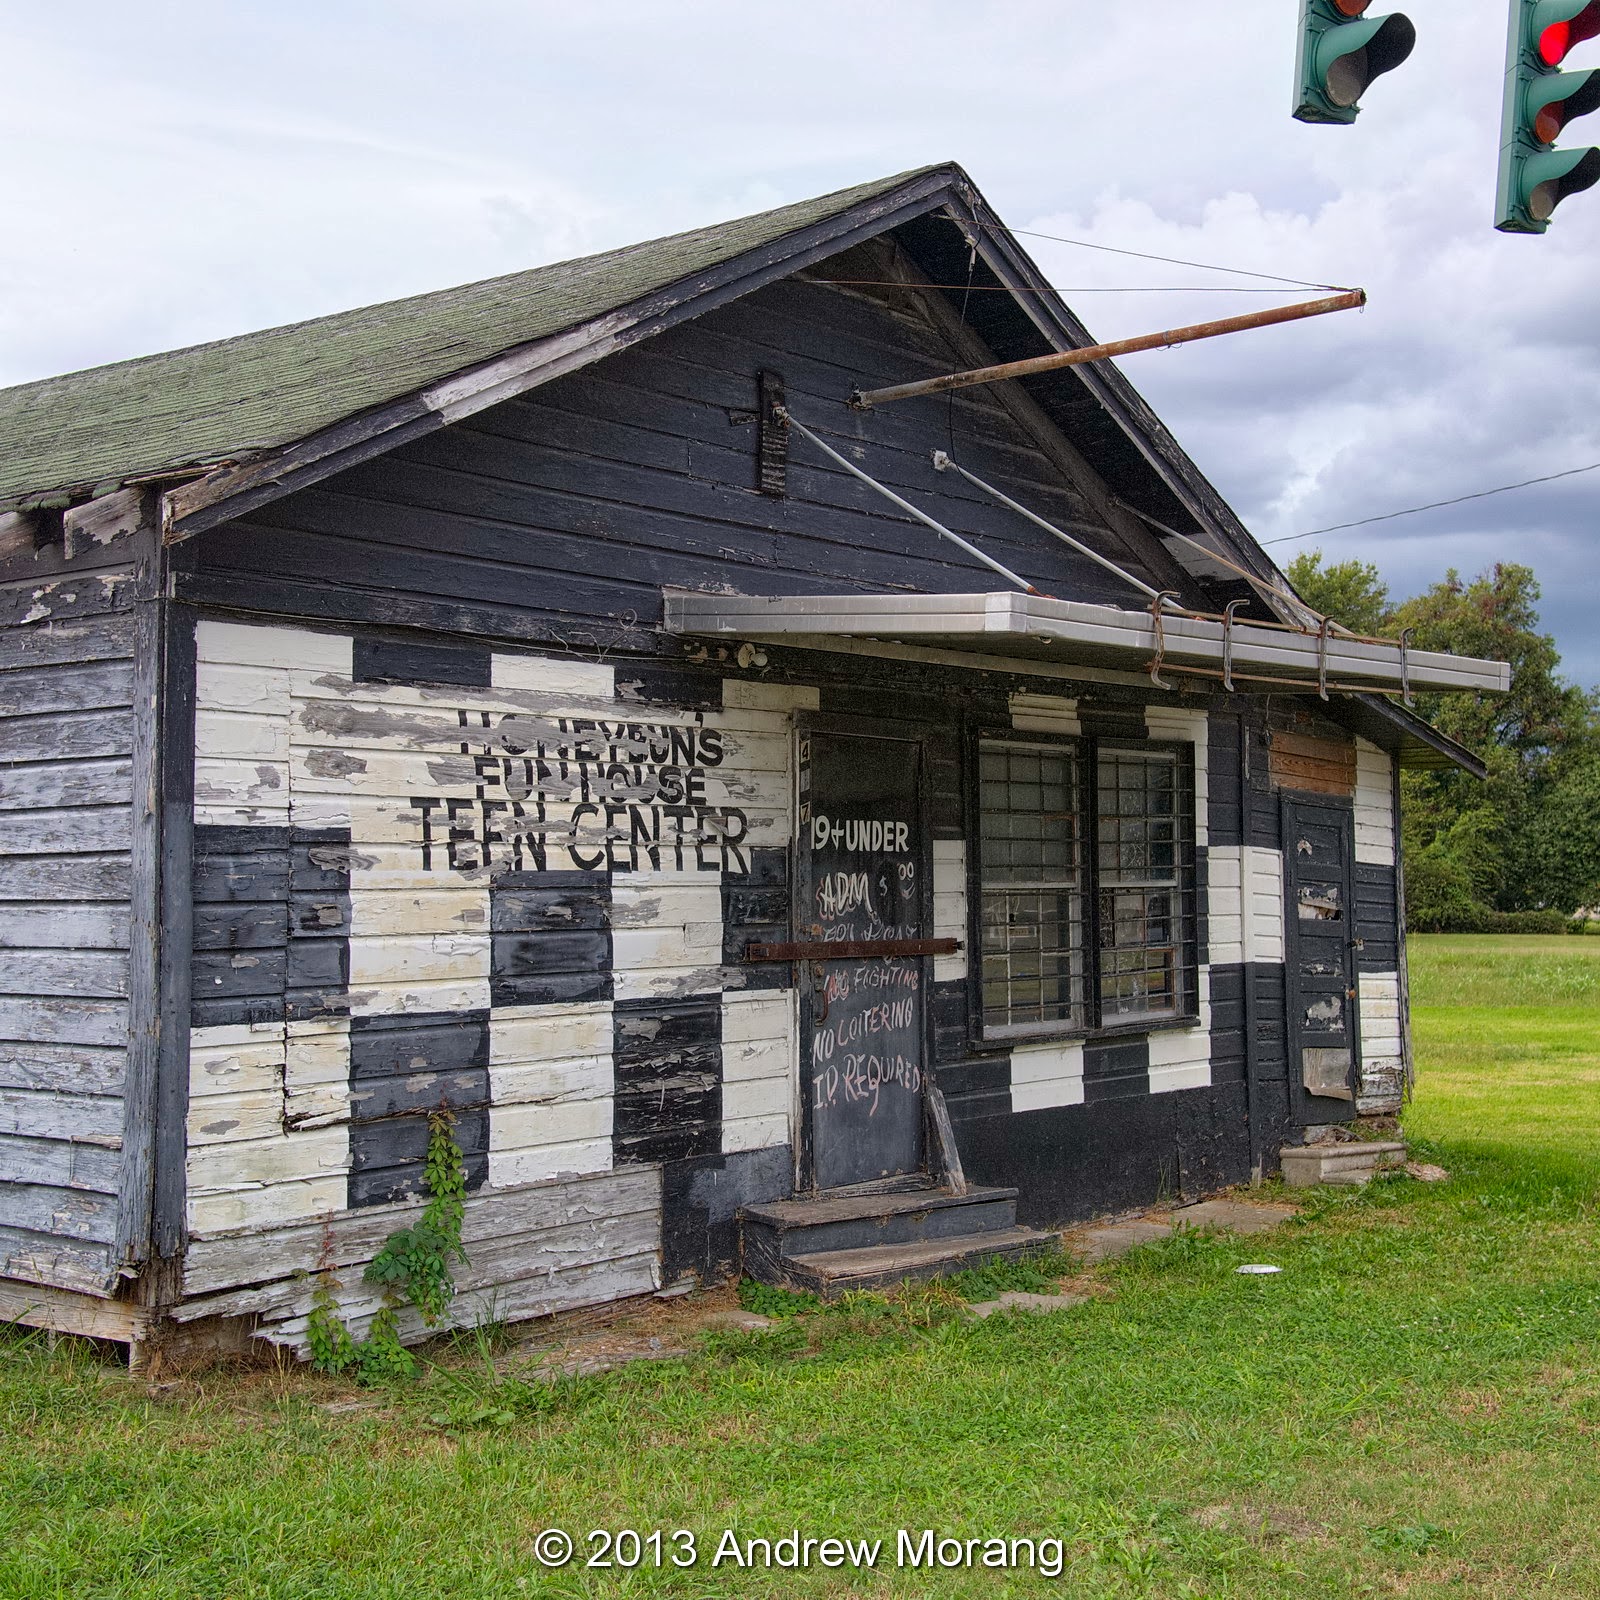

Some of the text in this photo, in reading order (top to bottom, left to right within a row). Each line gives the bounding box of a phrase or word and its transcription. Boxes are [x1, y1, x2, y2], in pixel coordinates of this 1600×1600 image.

[410, 797, 750, 875] TEEN CENTER
[854, 966, 919, 993] FIGHTING
[812, 996, 914, 1068] NO LOITERING
[842, 1053, 921, 1117] REQUIRED
